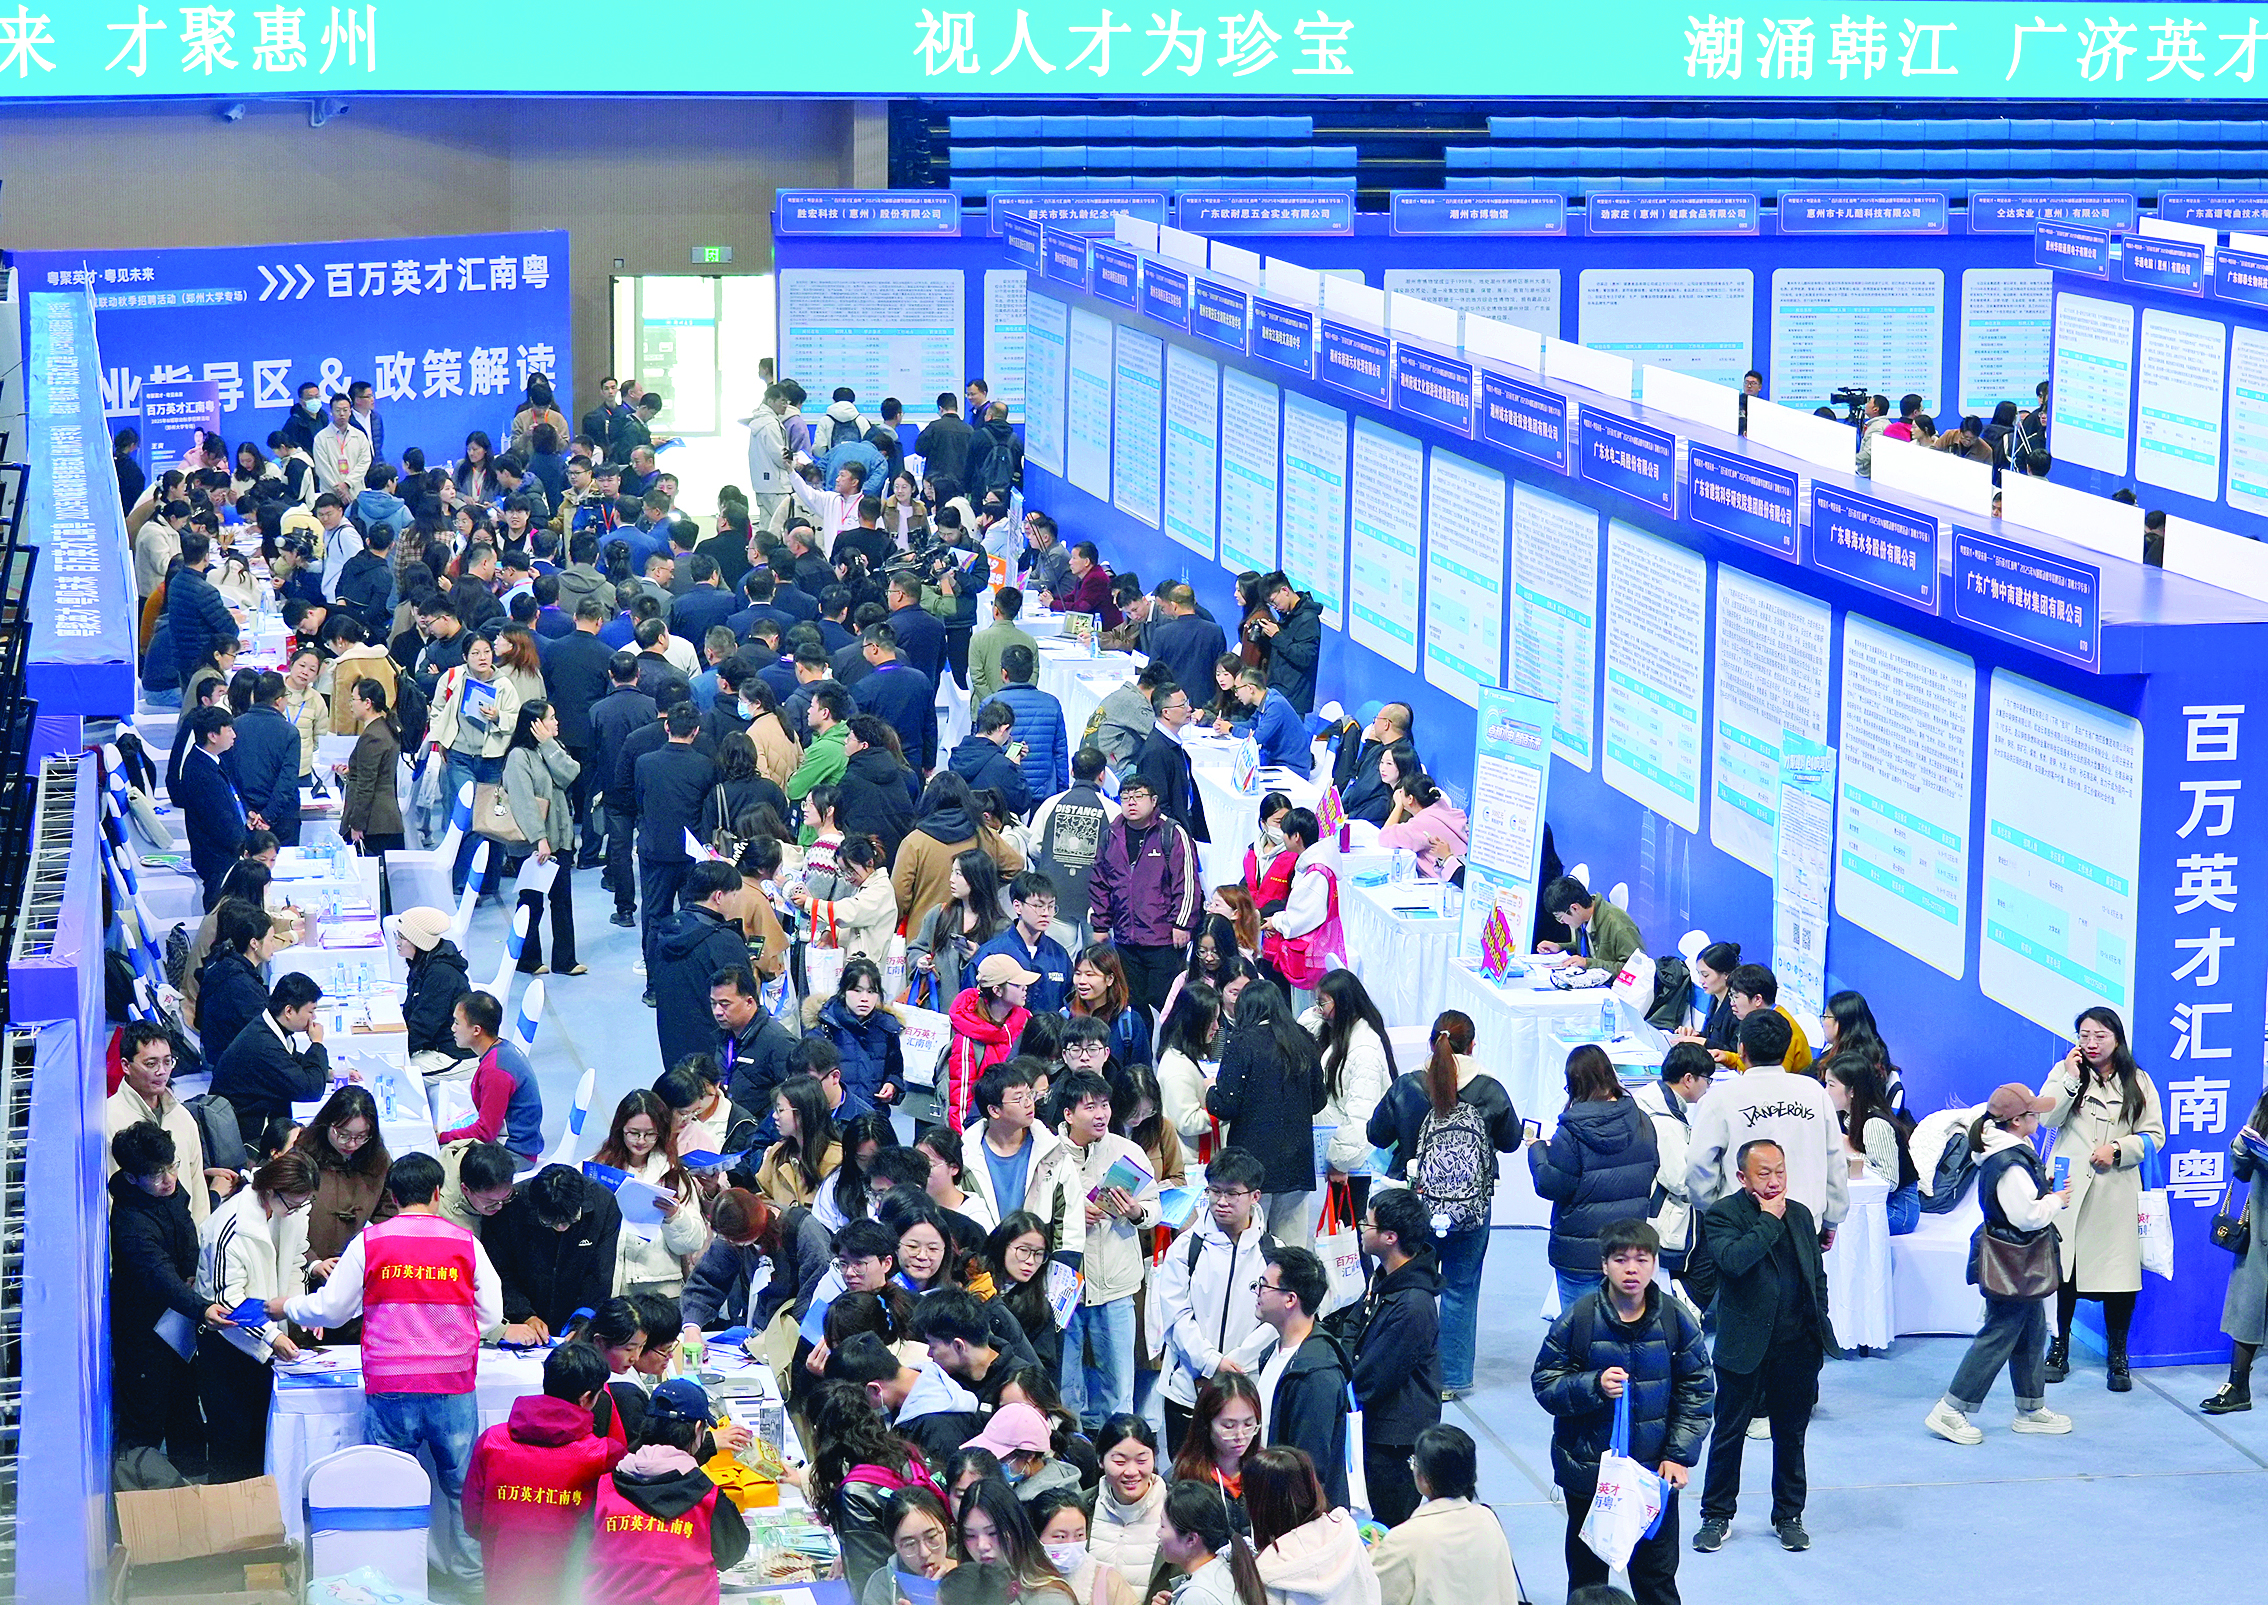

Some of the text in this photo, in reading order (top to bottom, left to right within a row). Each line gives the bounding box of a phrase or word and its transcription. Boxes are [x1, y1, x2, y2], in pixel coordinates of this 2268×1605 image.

[105, 5, 378, 78] 才聚惠州
[913, 8, 1355, 78] 视人才为珍宝
[1683, 14, 2268, 83] 潮涌韩江 广济英才
[797, 208, 942, 220] 胜宏科技（惠州）股份有限公司
[1449, 208, 1510, 220] 潮州市博物馆
[1600, 208, 1747, 220] 劲家庄（惠州）健康食品有限公司
[1806, 207, 1921, 219] 惠州市卡儿酷科技有限公司
[325, 253, 550, 299] 百万英才汇南粤
[321, 357, 352, 398] &
[375, 343, 557, 403] 政策解读
[146, 400, 215, 416] 百万英才汇南粤
[1593, 441, 1660, 481] 广东水电二局股份有限公司
[1693, 477, 1792, 528] 广东省建筑科学研究院集团股份有限公司
[51, 521, 102, 573] 百万英才汇南粤
[1830, 523, 1917, 572] 广东粤海水务股份有限公司
[1920, 584, 1928, 596] 077
[1967, 570, 2083, 628] 广东广物中南建材集团有限公司
[1055, 803, 1104, 819] DISTANCE
[2166, 705, 2245, 1208] 百万英才汇南粤
[381, 1264, 459, 1282] 百万英才汇南粤
[496, 1484, 583, 1507] 百万英才汇南粤
[605, 1515, 694, 1540] 百万英才汇南粤
